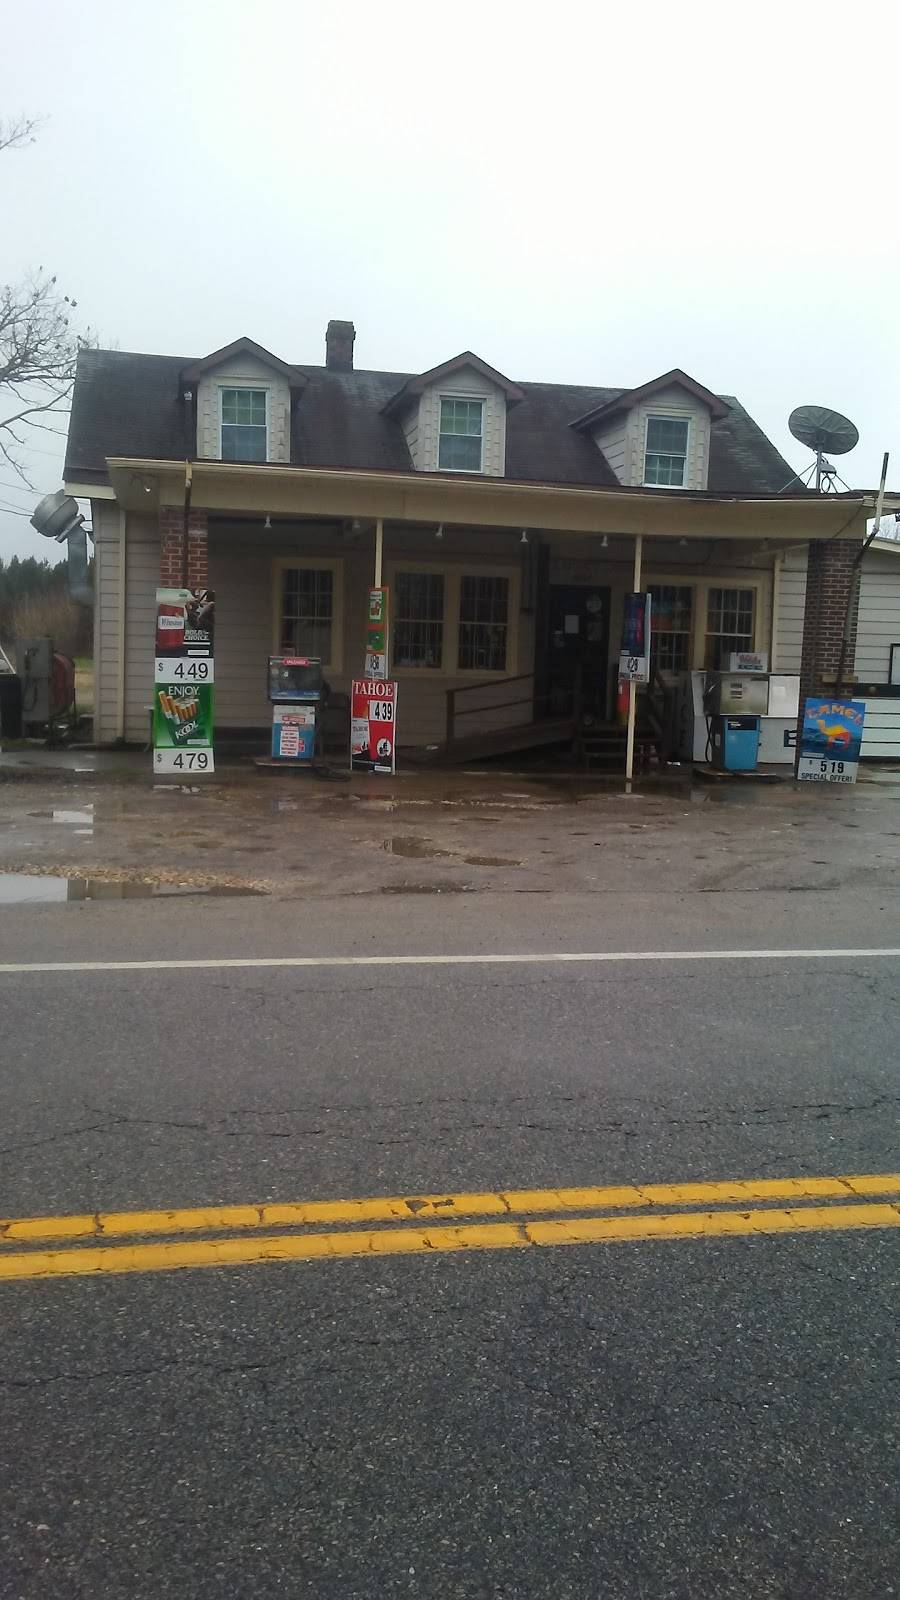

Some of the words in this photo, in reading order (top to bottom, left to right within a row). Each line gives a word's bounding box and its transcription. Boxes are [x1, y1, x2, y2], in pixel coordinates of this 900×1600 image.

[158, 662, 164, 672] $
[355, 681, 393, 697] TAHOE
[806, 704, 862, 726] CAMEL
[175, 720, 199, 739] KOOL
[157, 753, 163, 762] $
[801, 772, 827, 780] SPECIAL
